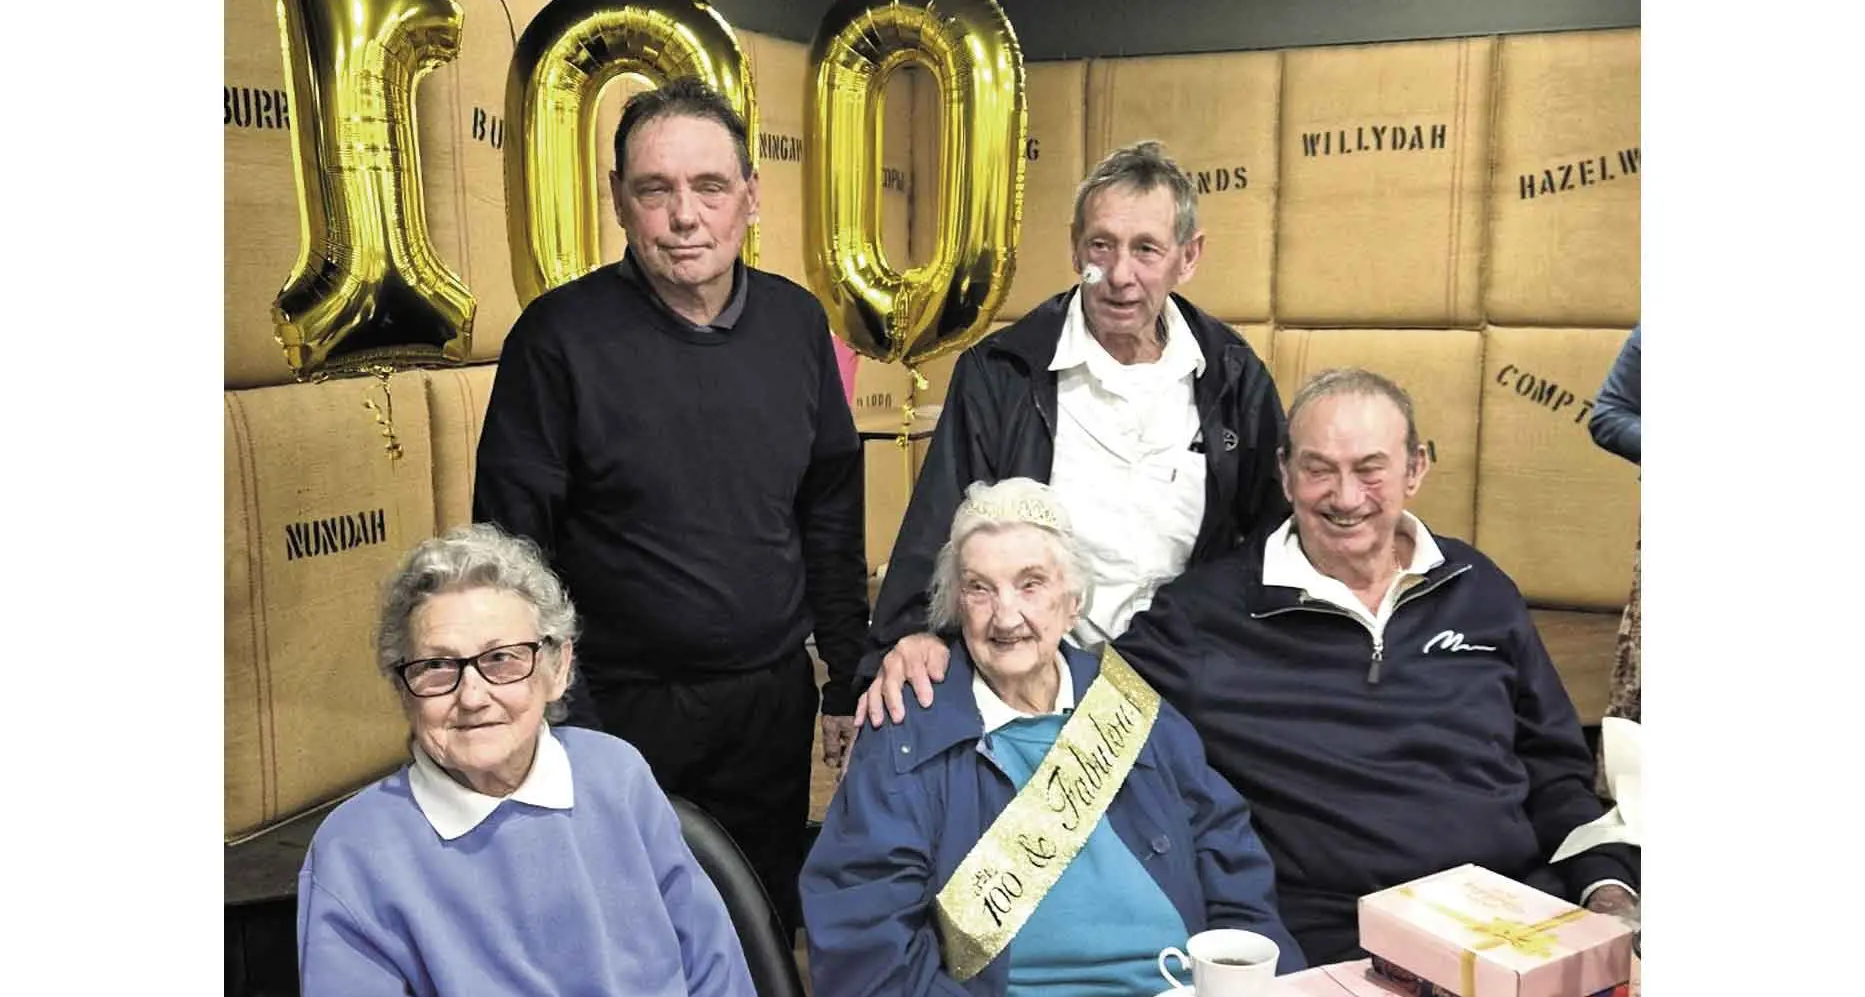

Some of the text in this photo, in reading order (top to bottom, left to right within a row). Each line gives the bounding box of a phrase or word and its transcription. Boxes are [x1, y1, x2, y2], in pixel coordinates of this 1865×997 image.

[1302, 124, 1447, 156] WILLYDAH
[286, 508, 386, 560] NUNDAH
[983, 871, 1023, 927] 100
[1018, 834, 1056, 868] &
